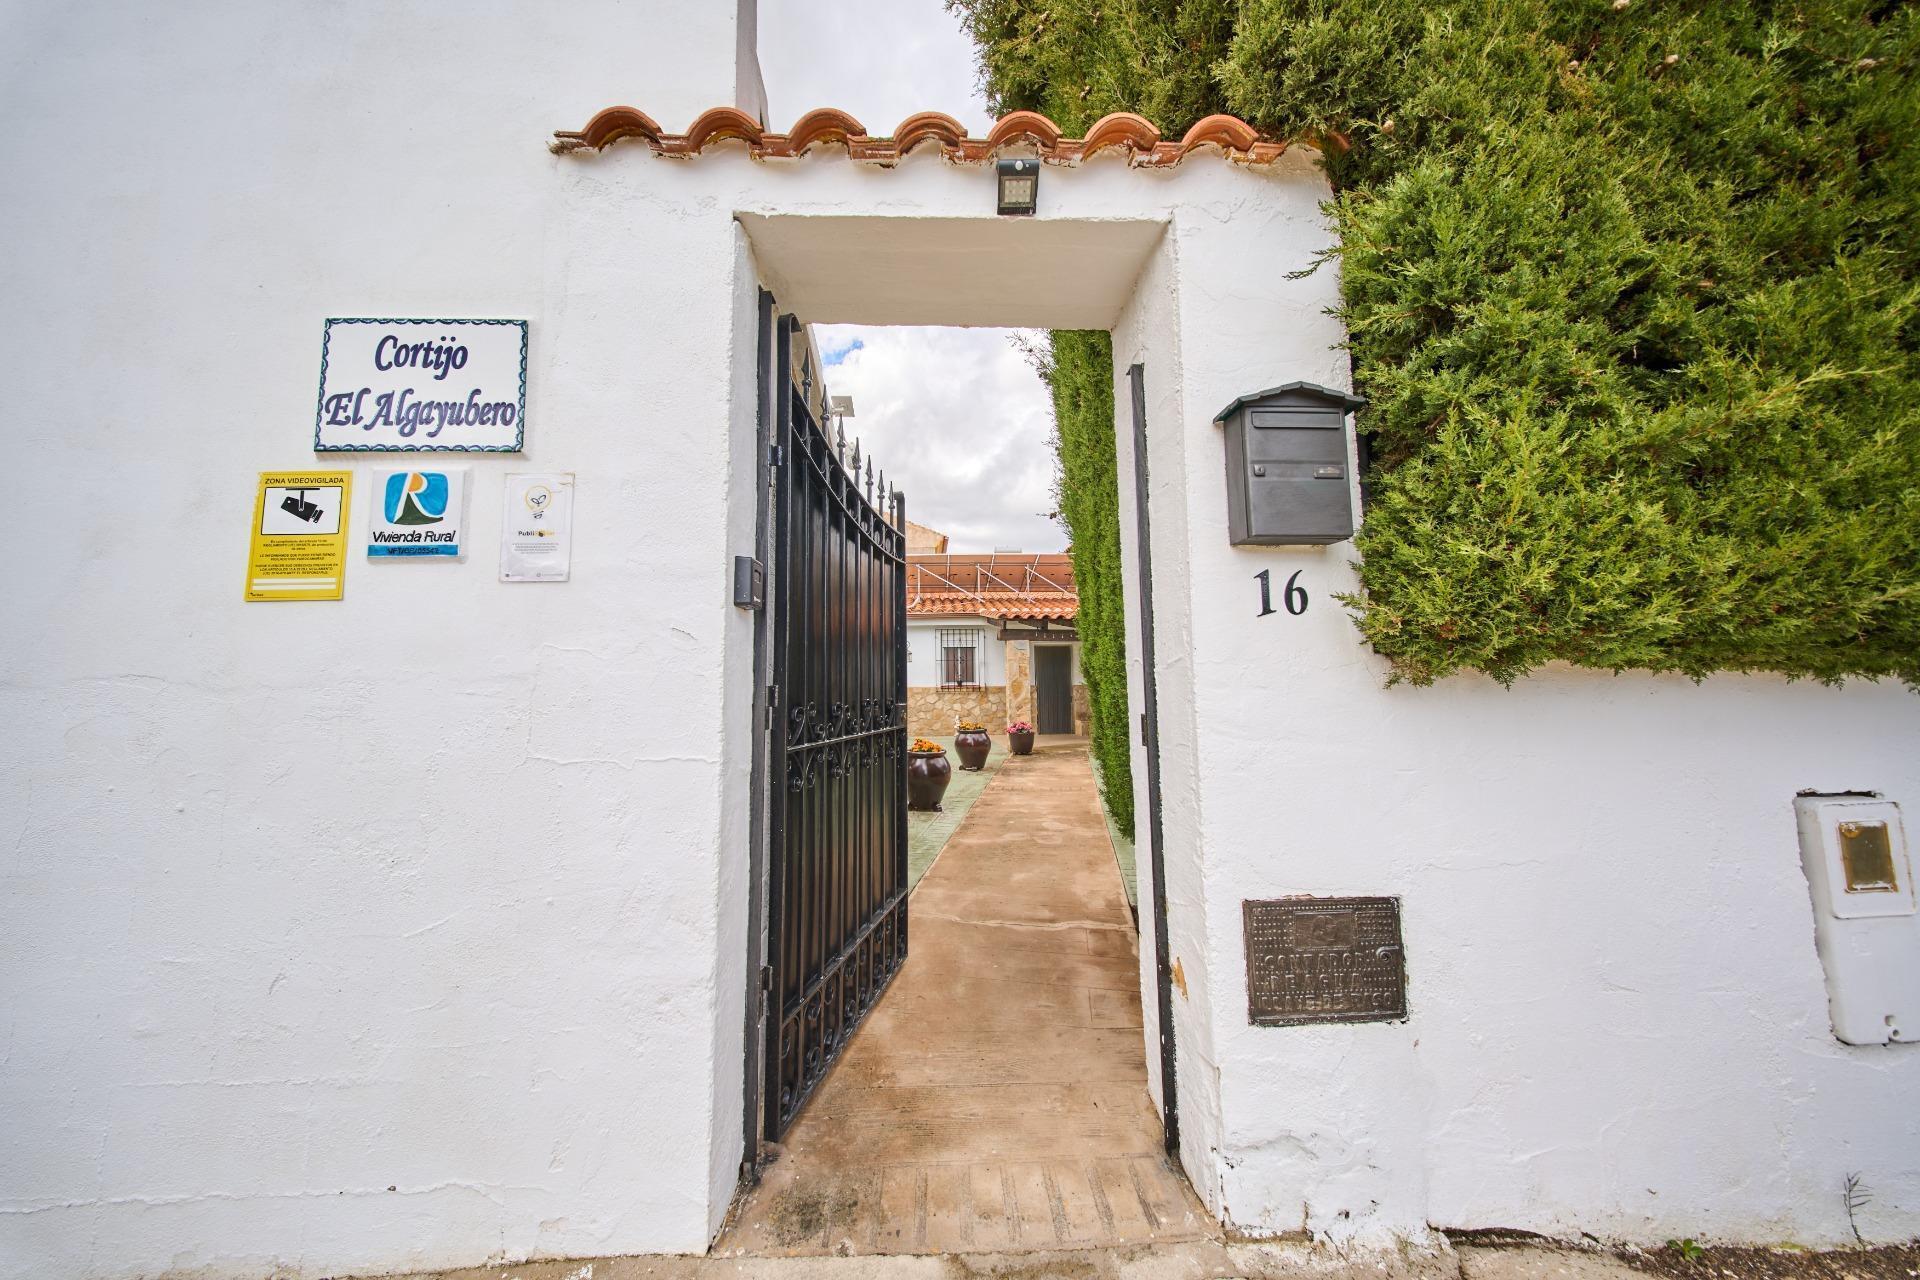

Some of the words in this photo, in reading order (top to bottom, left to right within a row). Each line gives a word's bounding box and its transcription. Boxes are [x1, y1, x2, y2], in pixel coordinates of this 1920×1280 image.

[375, 335, 468, 380] Cortijo
[325, 388, 371, 426] El
[363, 388, 516, 437] Algayubero
[373, 530, 422, 542] Vivienda
[424, 530, 456, 542] Rural
[1253, 568, 1309, 618] 16
